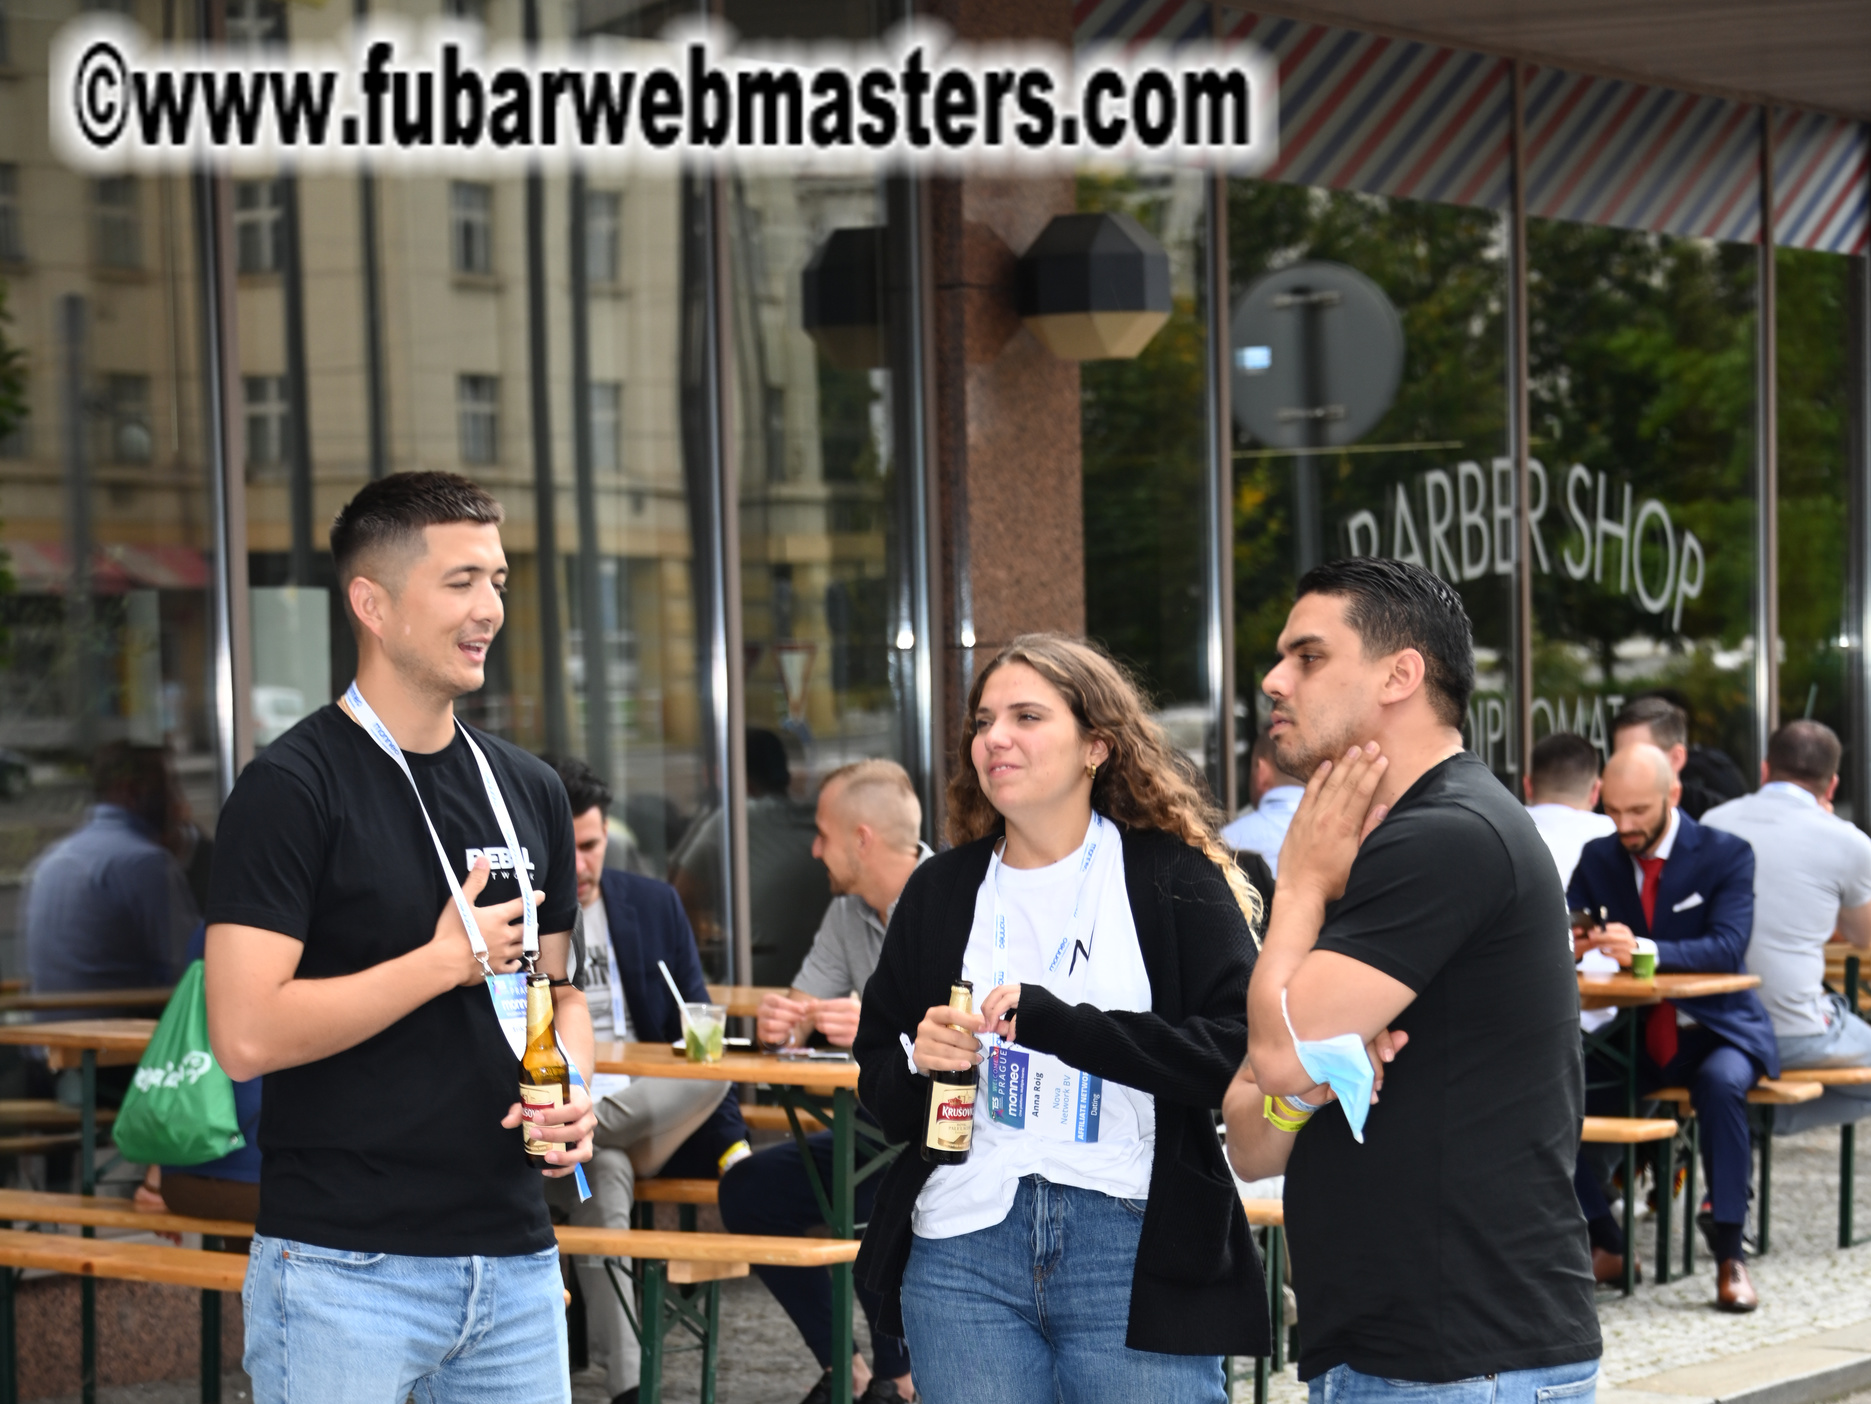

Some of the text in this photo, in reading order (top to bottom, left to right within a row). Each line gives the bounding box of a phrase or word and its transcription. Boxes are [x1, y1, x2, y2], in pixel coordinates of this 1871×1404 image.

[1564, 462, 1705, 632] SHOP
[372, 722, 401, 757] monneo
[465, 846, 535, 871] REBL
[1049, 937, 1068, 972] monneo
[998, 1050, 1008, 1096] PRAGUE
[1009, 1063, 1020, 1117] monneo
[1031, 1072, 1044, 1117] Anna Roig
[1053, 1087, 1061, 1110] Nova
[1060, 1074, 1071, 1125] Network BV
[1090, 1093, 1101, 1116] Dating
[1077, 1101, 1088, 1140] AFFILIATE
